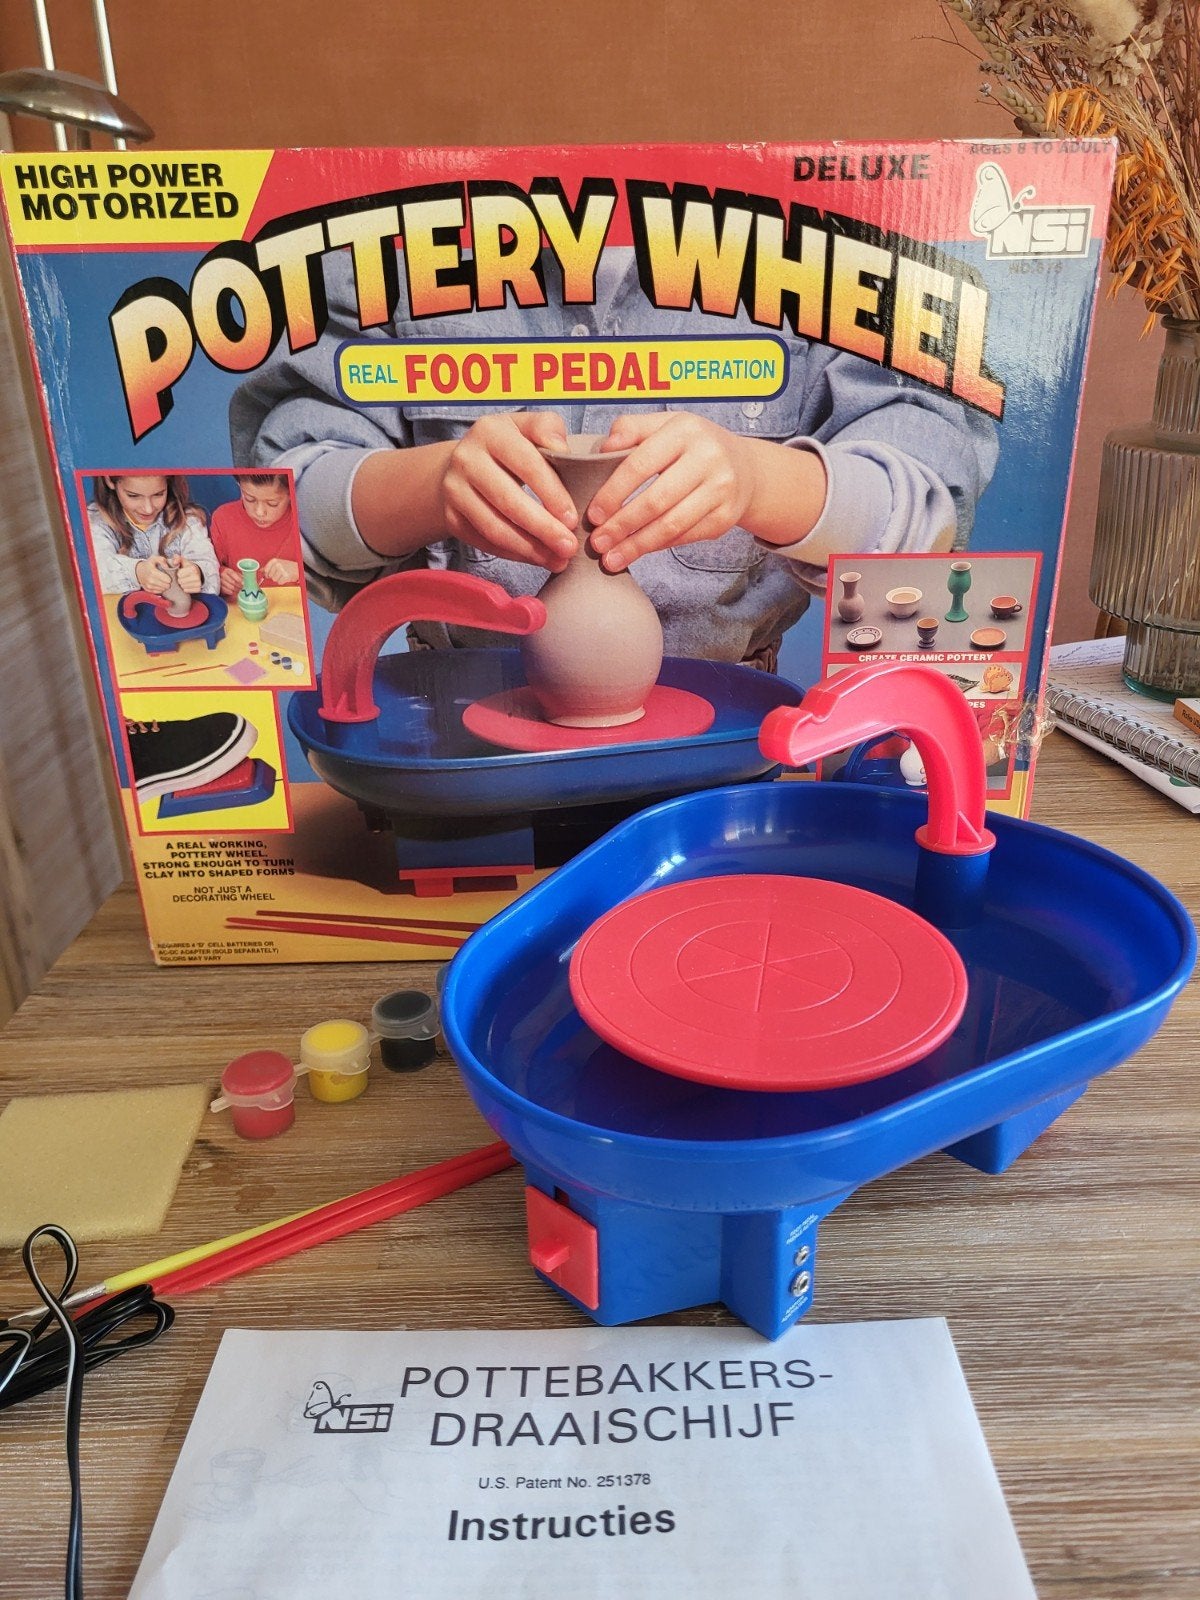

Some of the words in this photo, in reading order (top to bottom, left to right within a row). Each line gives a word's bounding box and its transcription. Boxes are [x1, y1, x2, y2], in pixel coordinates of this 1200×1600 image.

[1033, 142, 1054, 154] TO
[793, 154, 930, 182] DELUXE
[14, 164, 98, 189] HIGH
[106, 163, 224, 189] POWER
[20, 191, 239, 221] MOTORIZED
[109, 177, 619, 444] POTTERY
[625, 178, 1005, 422] WHEEL
[348, 363, 398, 385] REAL
[404, 353, 519, 395] FOOT
[533, 351, 671, 393] PEDAL
[669, 358, 776, 382] OPERATION
[900, 653, 945, 662] CERAMIC
[946, 653, 994, 661] POTTERY
[165, 842, 174, 850] A
[176, 841, 207, 850] REAL
[208, 840, 268, 850] WORKING,
[170, 850, 222, 859] POTTERY
[143, 861, 191, 870] STRONG
[193, 860, 241, 868] ENOUGH
[245, 859, 260, 867] TO
[264, 858, 295, 867] TURN
[145, 871, 175, 879] CLAY
[178, 870, 206, 878] INTO
[208, 869, 254, 877] SHAPED
[256, 868, 295, 876] FORMS
[193, 886, 214, 894] NOT
[217, 885, 243, 894] JUST
[244, 885, 252, 893] A
[172, 894, 238, 903] DECORATING
[240, 893, 276, 901] WHEEL
[233, 947, 279, 955] SEPARATELY)
[400, 1359, 834, 1399] POTTEBAKKERS-
[429, 1402, 796, 1447] DRAAISCHIJF
[478, 1476, 510, 1489] U.S.
[515, 1475, 562, 1489] Patent
[566, 1476, 592, 1489] No.
[596, 1473, 652, 1489] 251378
[448, 1504, 676, 1541] Instructies
